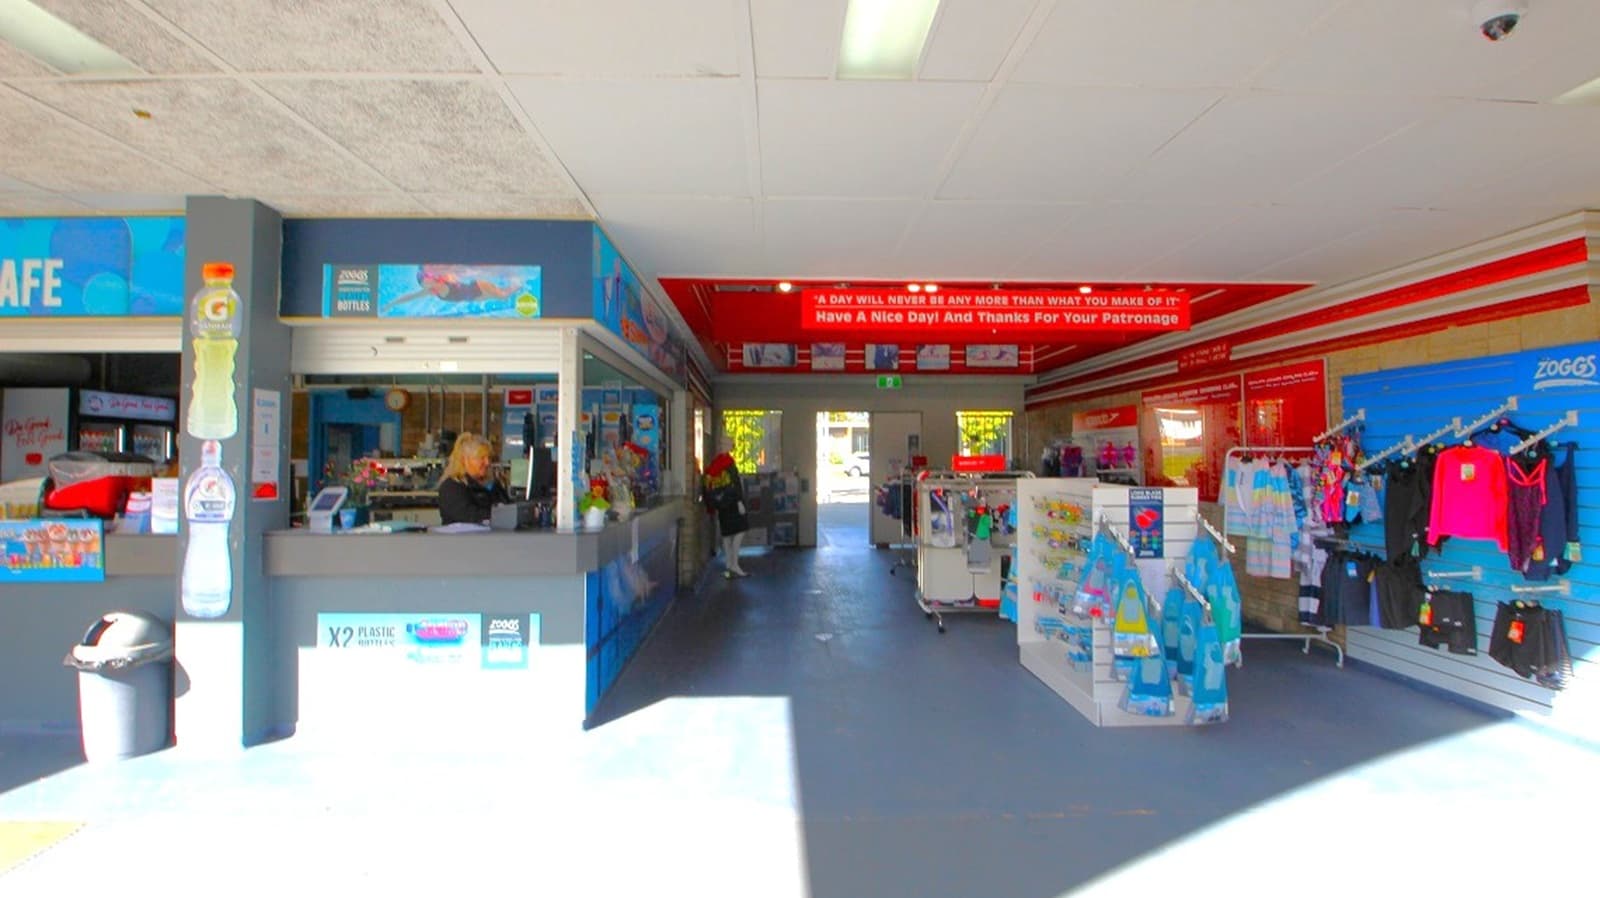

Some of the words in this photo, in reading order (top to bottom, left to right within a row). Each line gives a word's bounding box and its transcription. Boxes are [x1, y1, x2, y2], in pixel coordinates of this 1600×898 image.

[337, 300, 370, 312] BOTTLES
[829, 295, 853, 305] DAY
[856, 295, 884, 305] WILL
[888, 295, 926, 305] NEVER
[929, 295, 945, 305] BE
[947, 295, 972, 305] ANY
[975, 295, 1009, 306] MORE
[1012, 295, 1044, 306] THAN
[1047, 296, 1081, 306] WHAT
[1084, 296, 1108, 306] YOU
[1111, 296, 1144, 306] MAKE
[1147, 297, 1162, 306] OF
[816, 311, 852, 323] Have
[856, 311, 867, 323] A
[871, 310, 903, 323] Nice
[908, 311, 939, 325] Day!
[943, 311, 973, 323] And
[977, 311, 1030, 324] Thanks
[1034, 312, 1060, 324] For
[1063, 312, 1098, 324] Your
[1102, 312, 1179, 326] Patronage
[1533, 354, 1597, 379] ZOGGS
[328, 626, 354, 648] X2
[358, 626, 396, 638] PLASTIC
